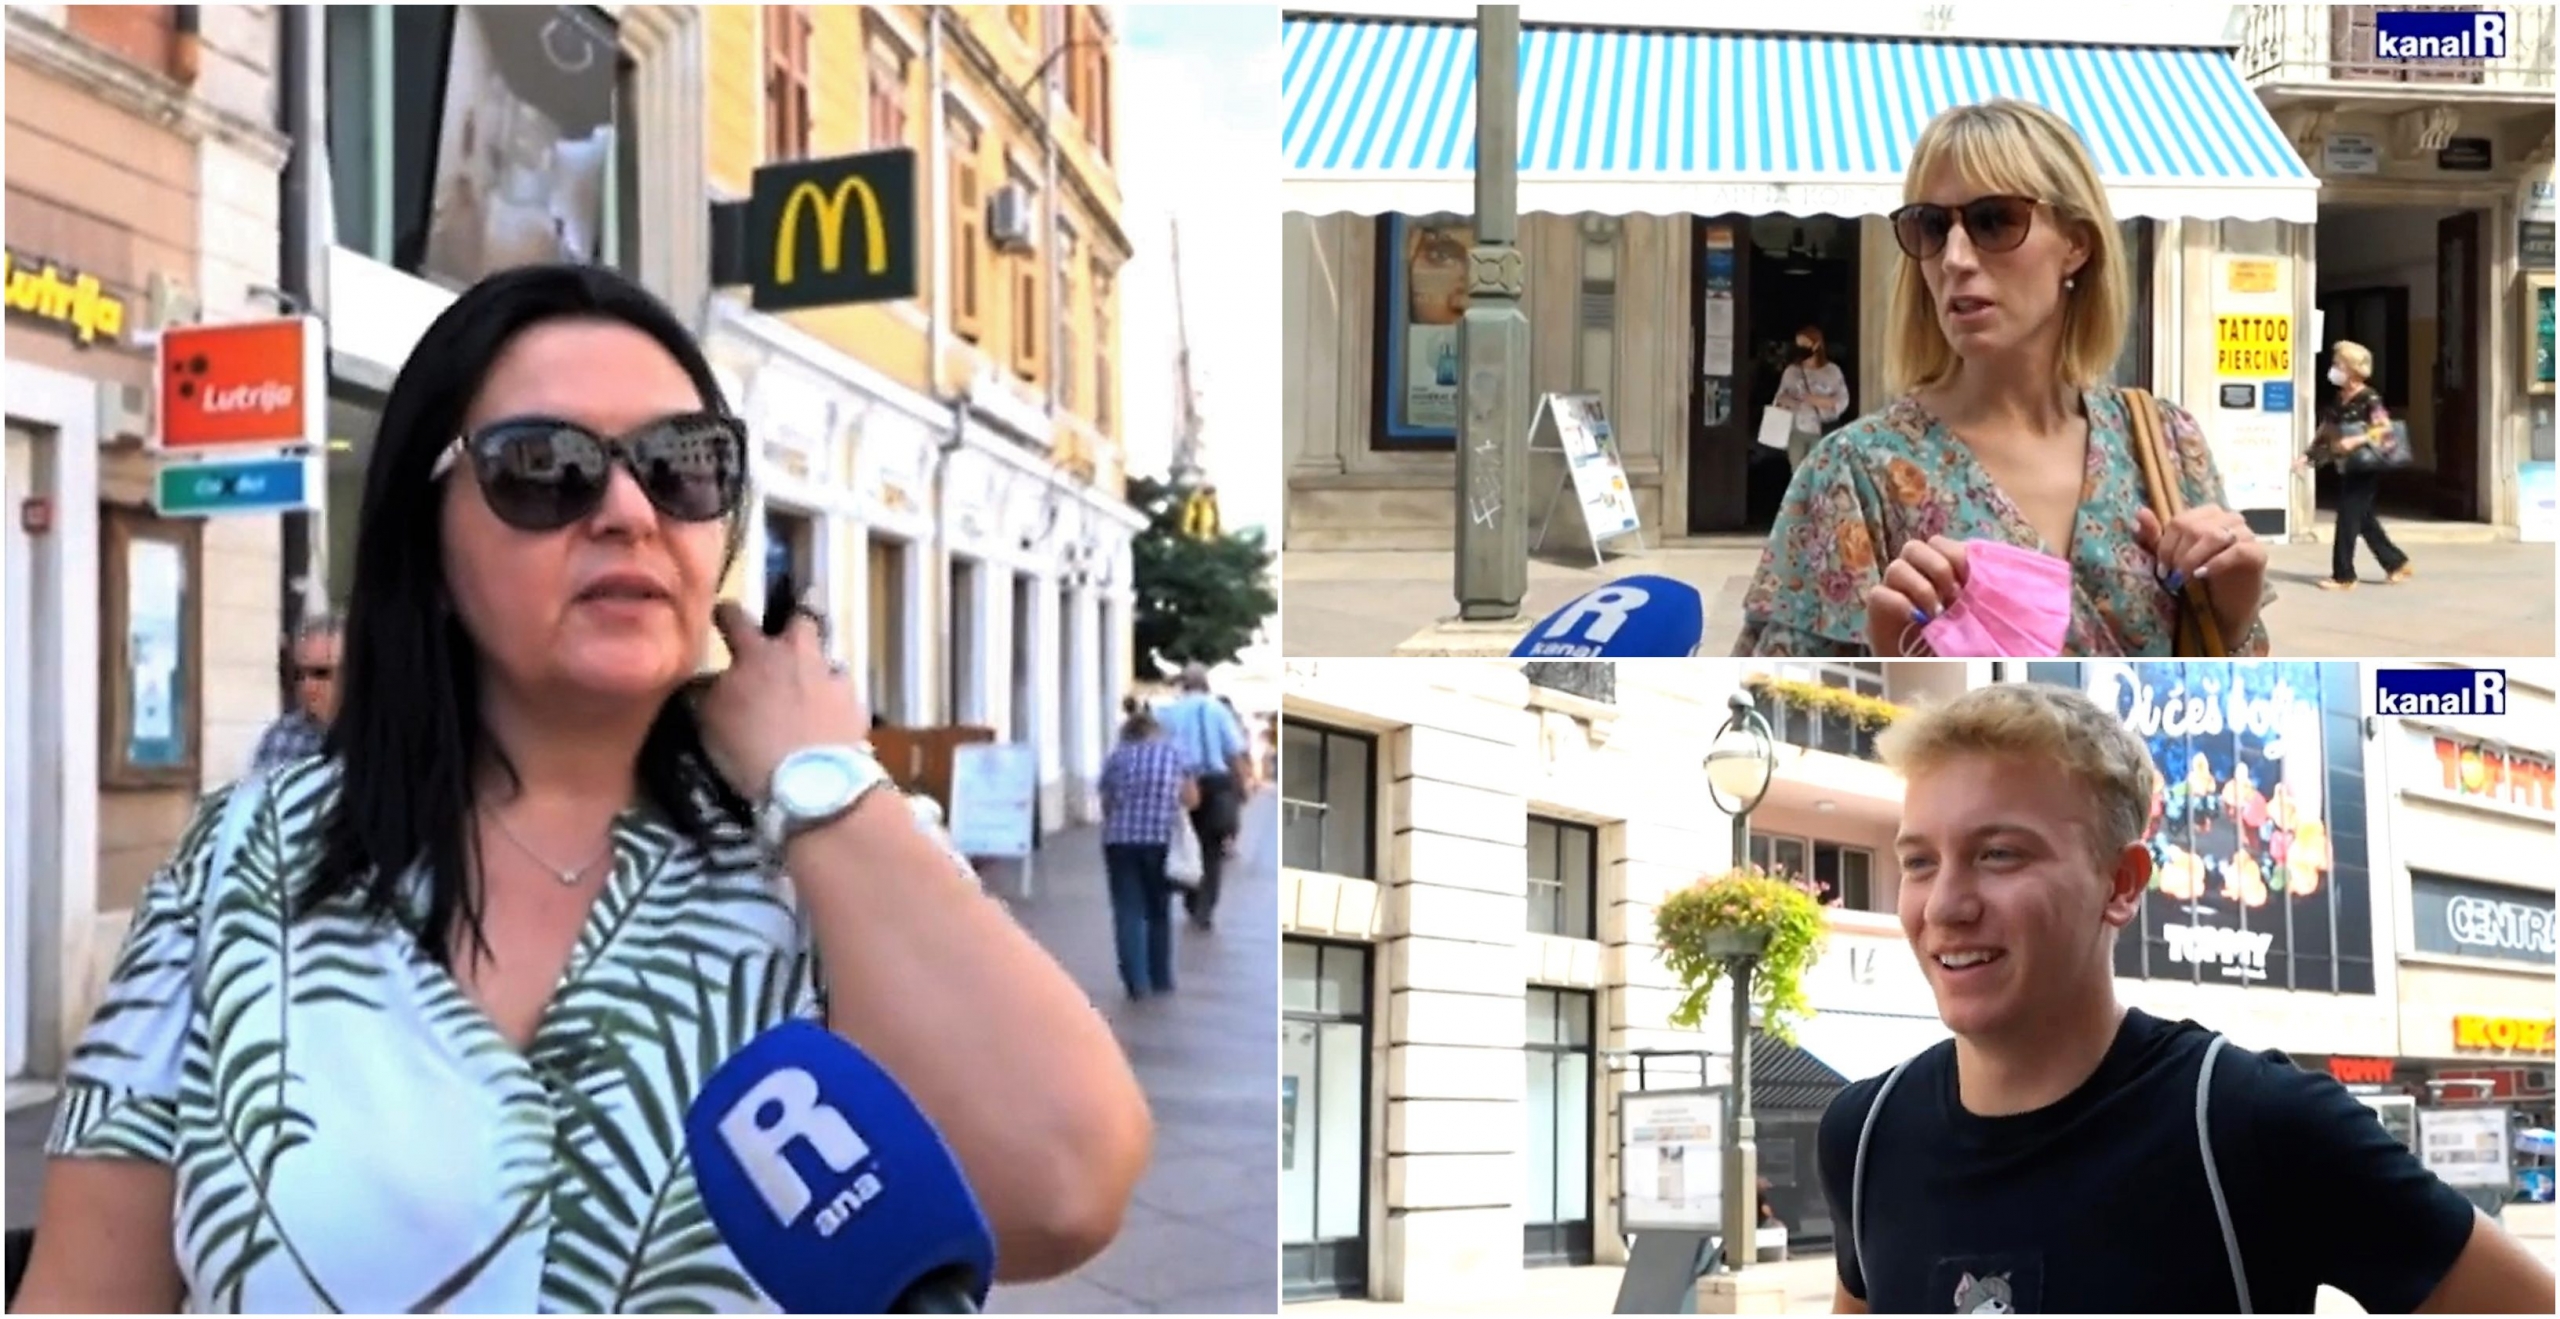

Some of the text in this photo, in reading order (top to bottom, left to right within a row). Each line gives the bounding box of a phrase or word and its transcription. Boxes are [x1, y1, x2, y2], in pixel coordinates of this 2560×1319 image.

[2218, 318, 2288, 342] TATTOO
[2218, 349, 2289, 370] PIERCING
[203, 380, 293, 414] Lutrija
[1542, 585, 1650, 644] R
[1528, 642, 1603, 657] kanal
[717, 1067, 870, 1228] R
